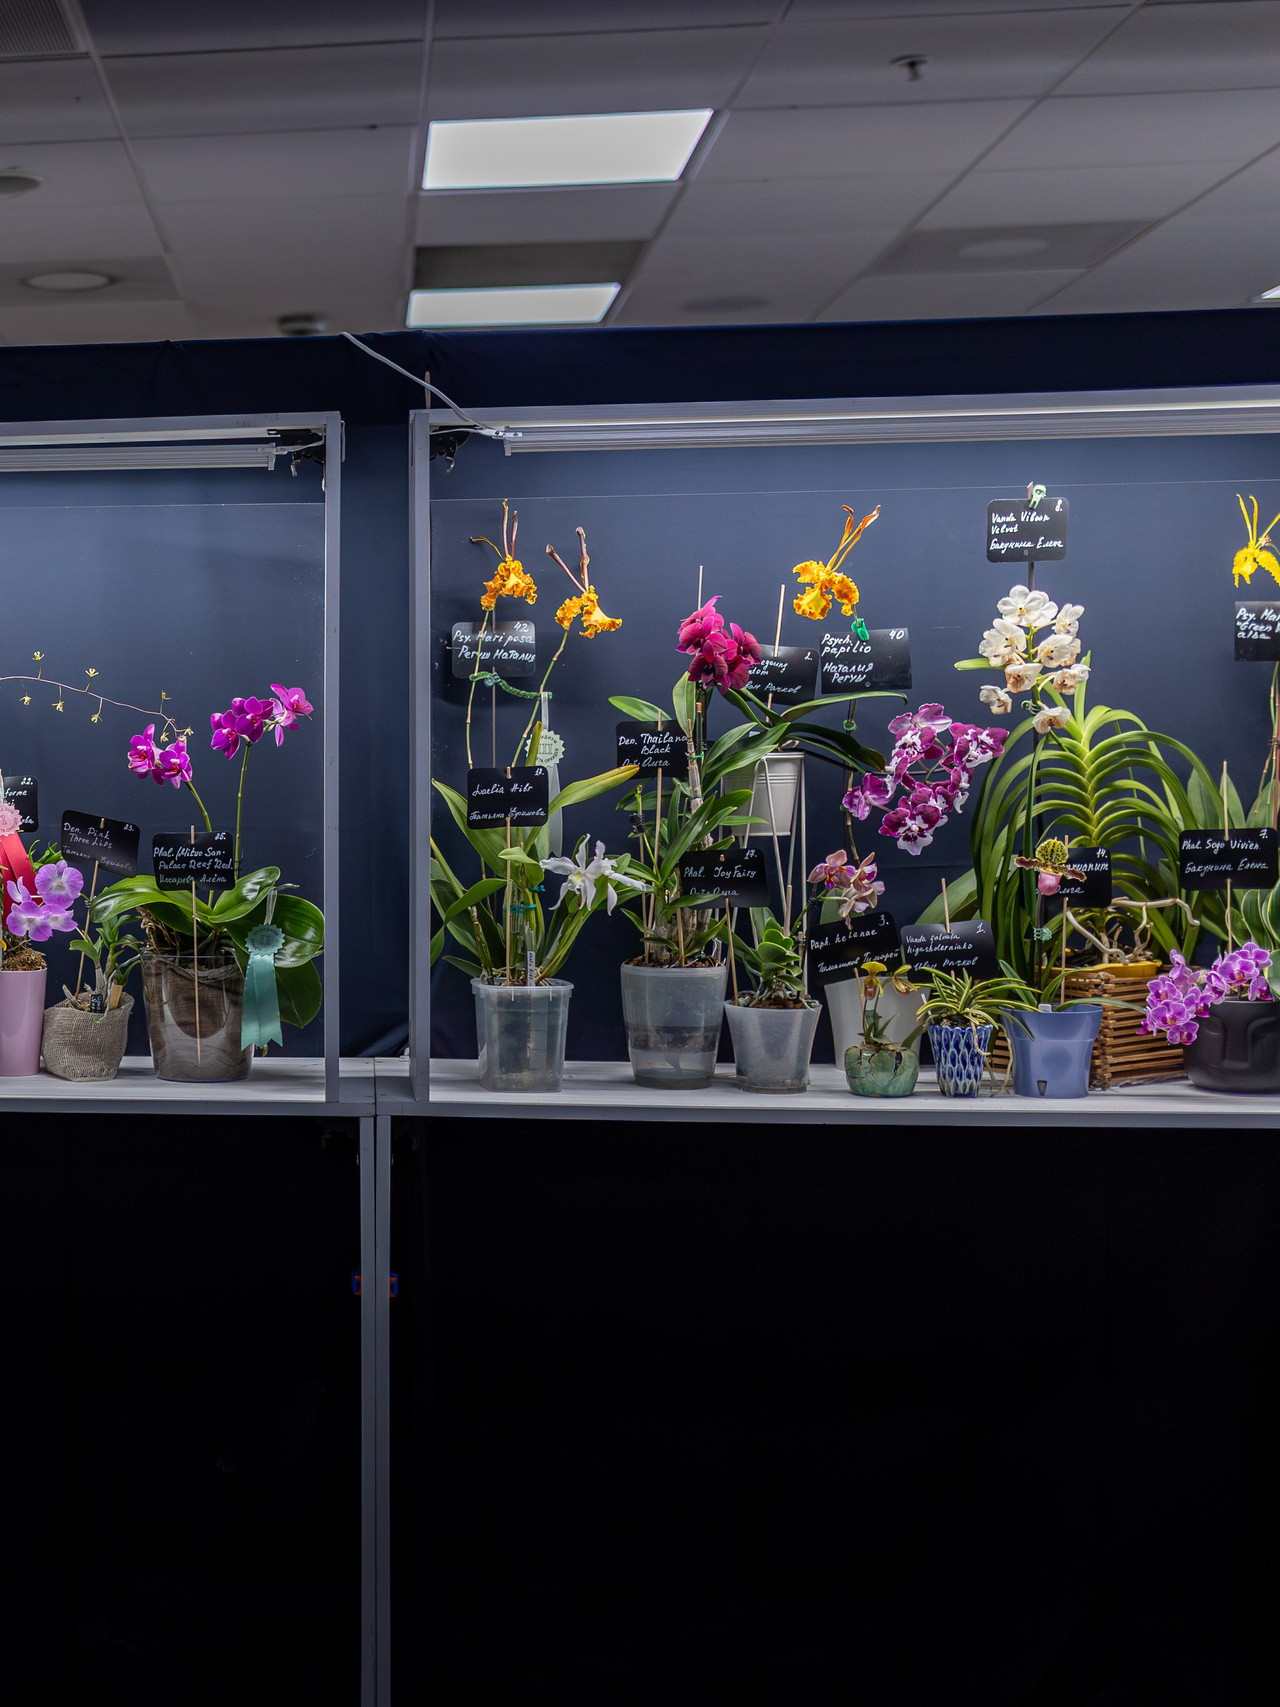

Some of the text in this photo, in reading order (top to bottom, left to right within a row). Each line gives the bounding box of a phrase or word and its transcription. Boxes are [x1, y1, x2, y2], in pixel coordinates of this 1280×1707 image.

[992, 512, 1017, 524] Vanda
[514, 621, 529, 633] 42
[452, 630, 472, 644] Psy.
[889, 629, 905, 640] 40
[1237, 630, 1271, 639] alba
[823, 662, 874, 673] Наталия
[618, 735, 638, 746] Den.
[640, 743, 671, 755] Black
[20, 777, 33, 786] 22.
[63, 822, 110, 840] Den. Pink
[215, 832, 227, 841] 25.
[69, 832, 90, 846] Three
[1205, 838, 1226, 855] Sogo
[1237, 858, 1269, 871] Елена
[683, 866, 706, 878] Phal.
[976, 922, 986, 934] 1.
